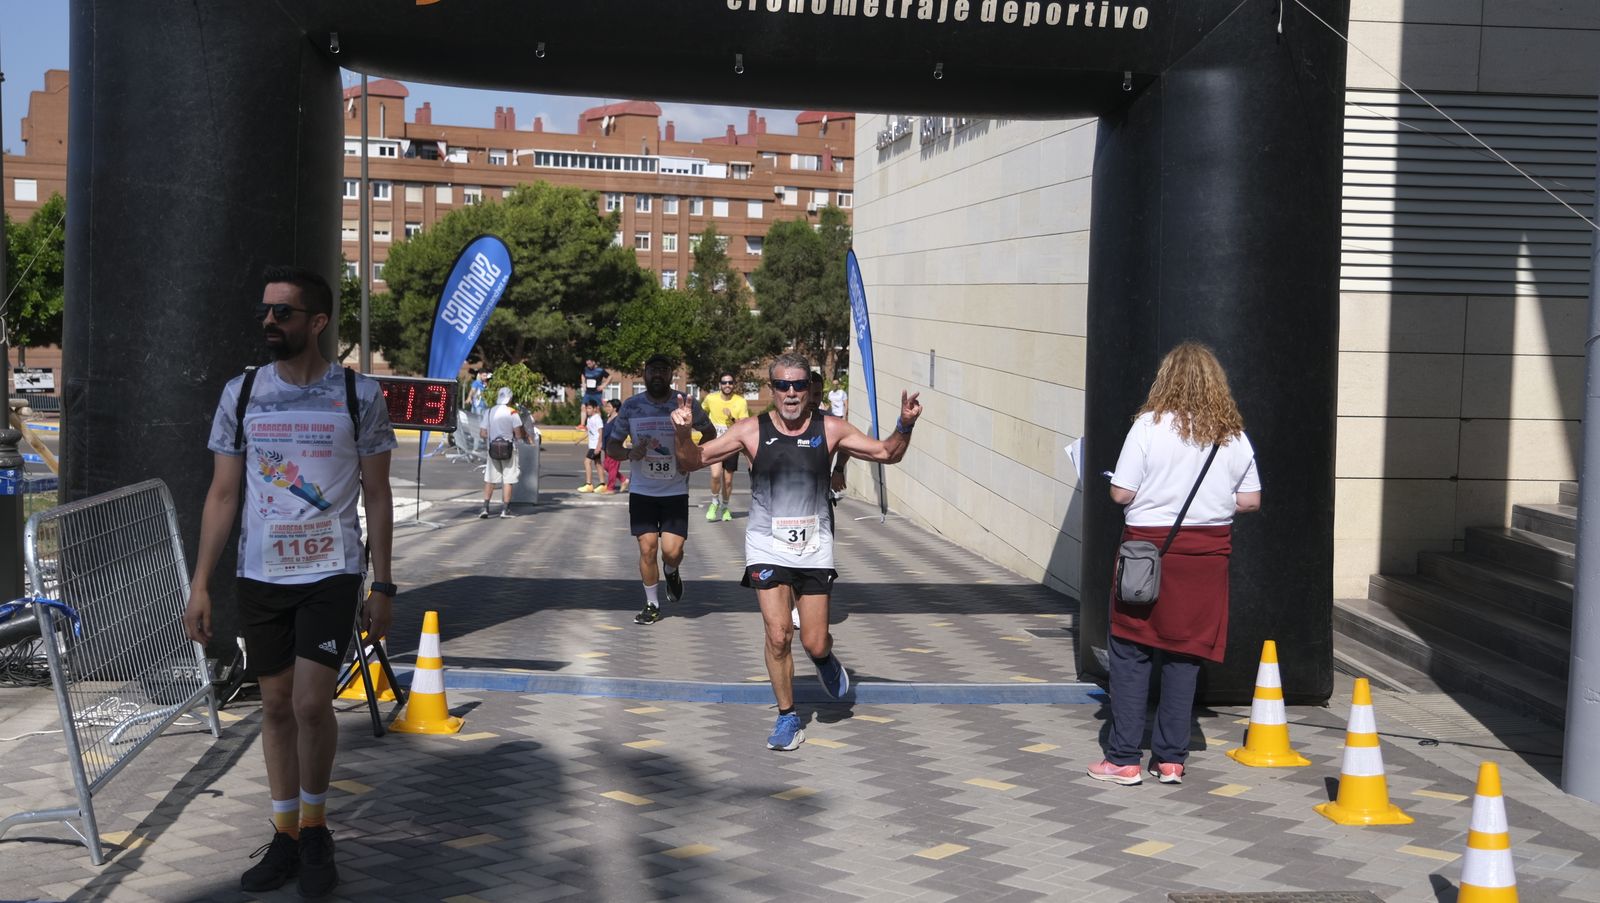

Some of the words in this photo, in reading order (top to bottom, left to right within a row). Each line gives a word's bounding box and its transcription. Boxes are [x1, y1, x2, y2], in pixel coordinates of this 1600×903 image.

[980, 0, 1149, 30] deportivo
[311, 424, 335, 433] HUMO
[649, 463, 670, 471] 138
[788, 528, 806, 543] 31
[273, 536, 335, 556] 1162
